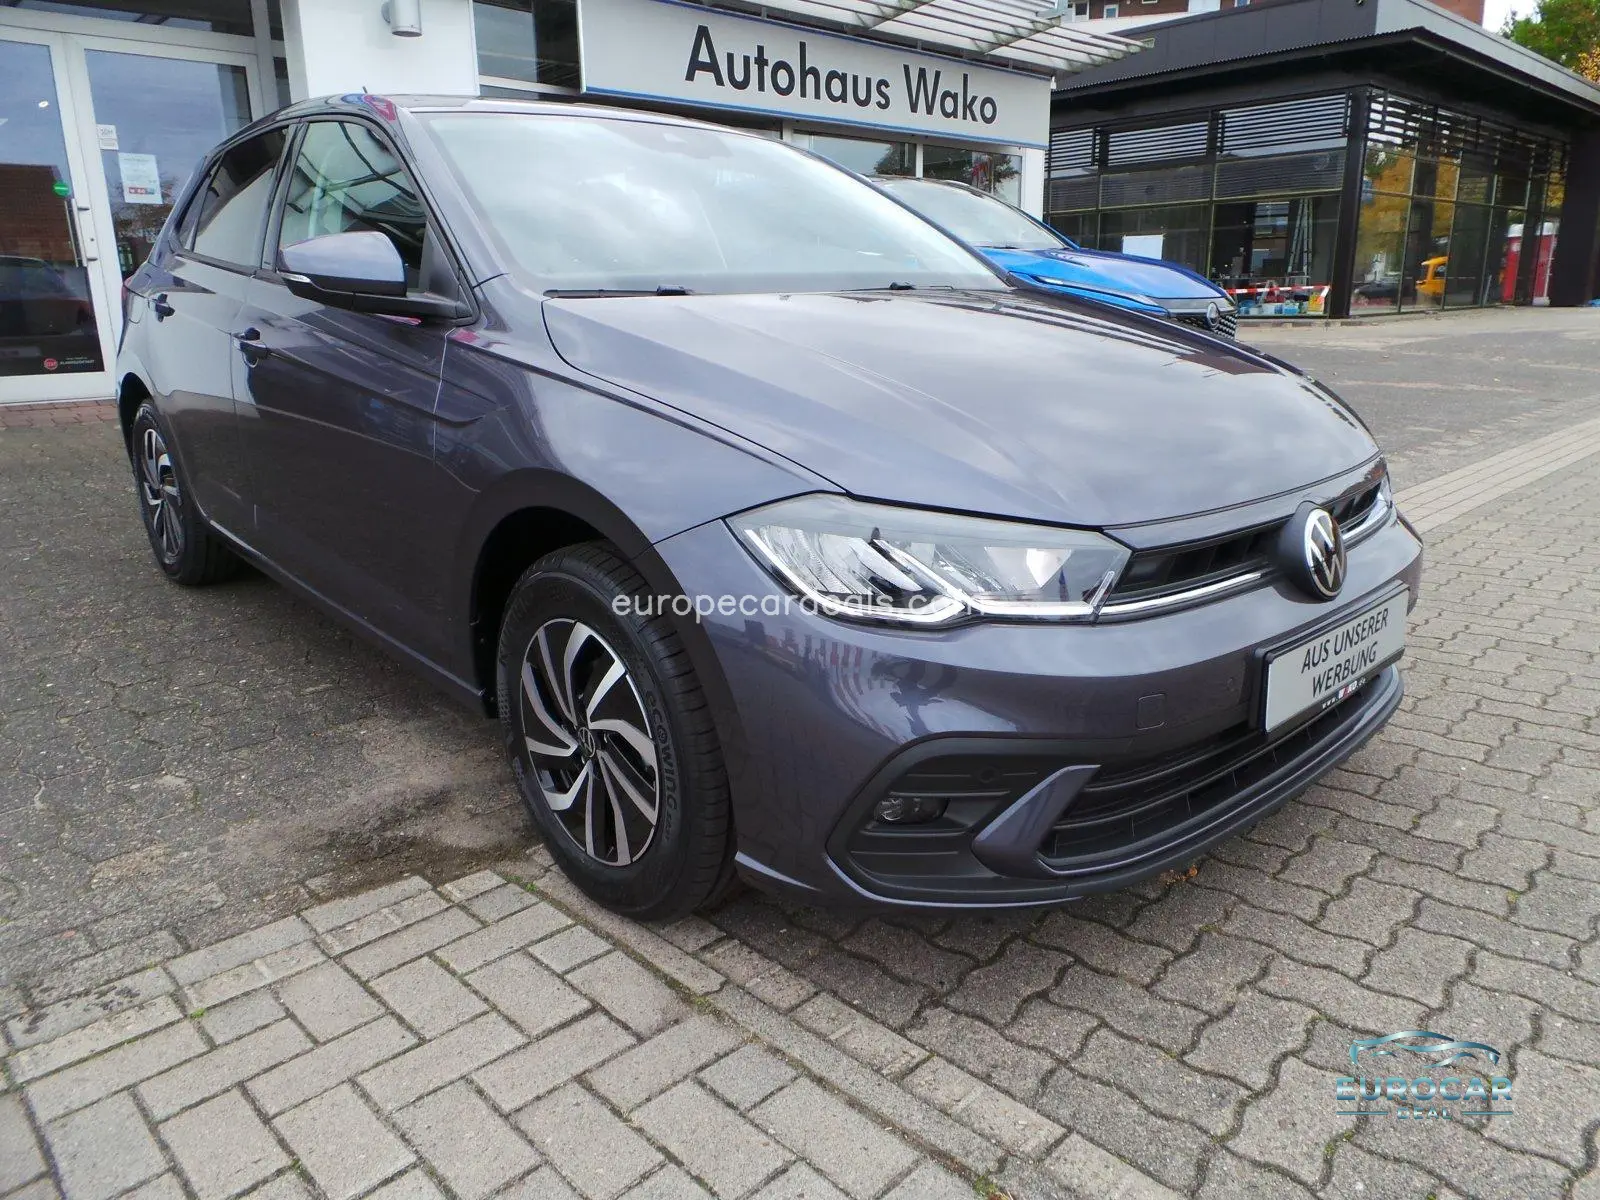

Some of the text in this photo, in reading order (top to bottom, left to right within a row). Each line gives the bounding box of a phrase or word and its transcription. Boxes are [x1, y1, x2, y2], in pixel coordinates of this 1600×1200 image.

[685, 24, 998, 125] Autohaus Wako
[1301, 608, 1389, 674] AUS UNSERER
[1312, 641, 1378, 698] WERBUNG
